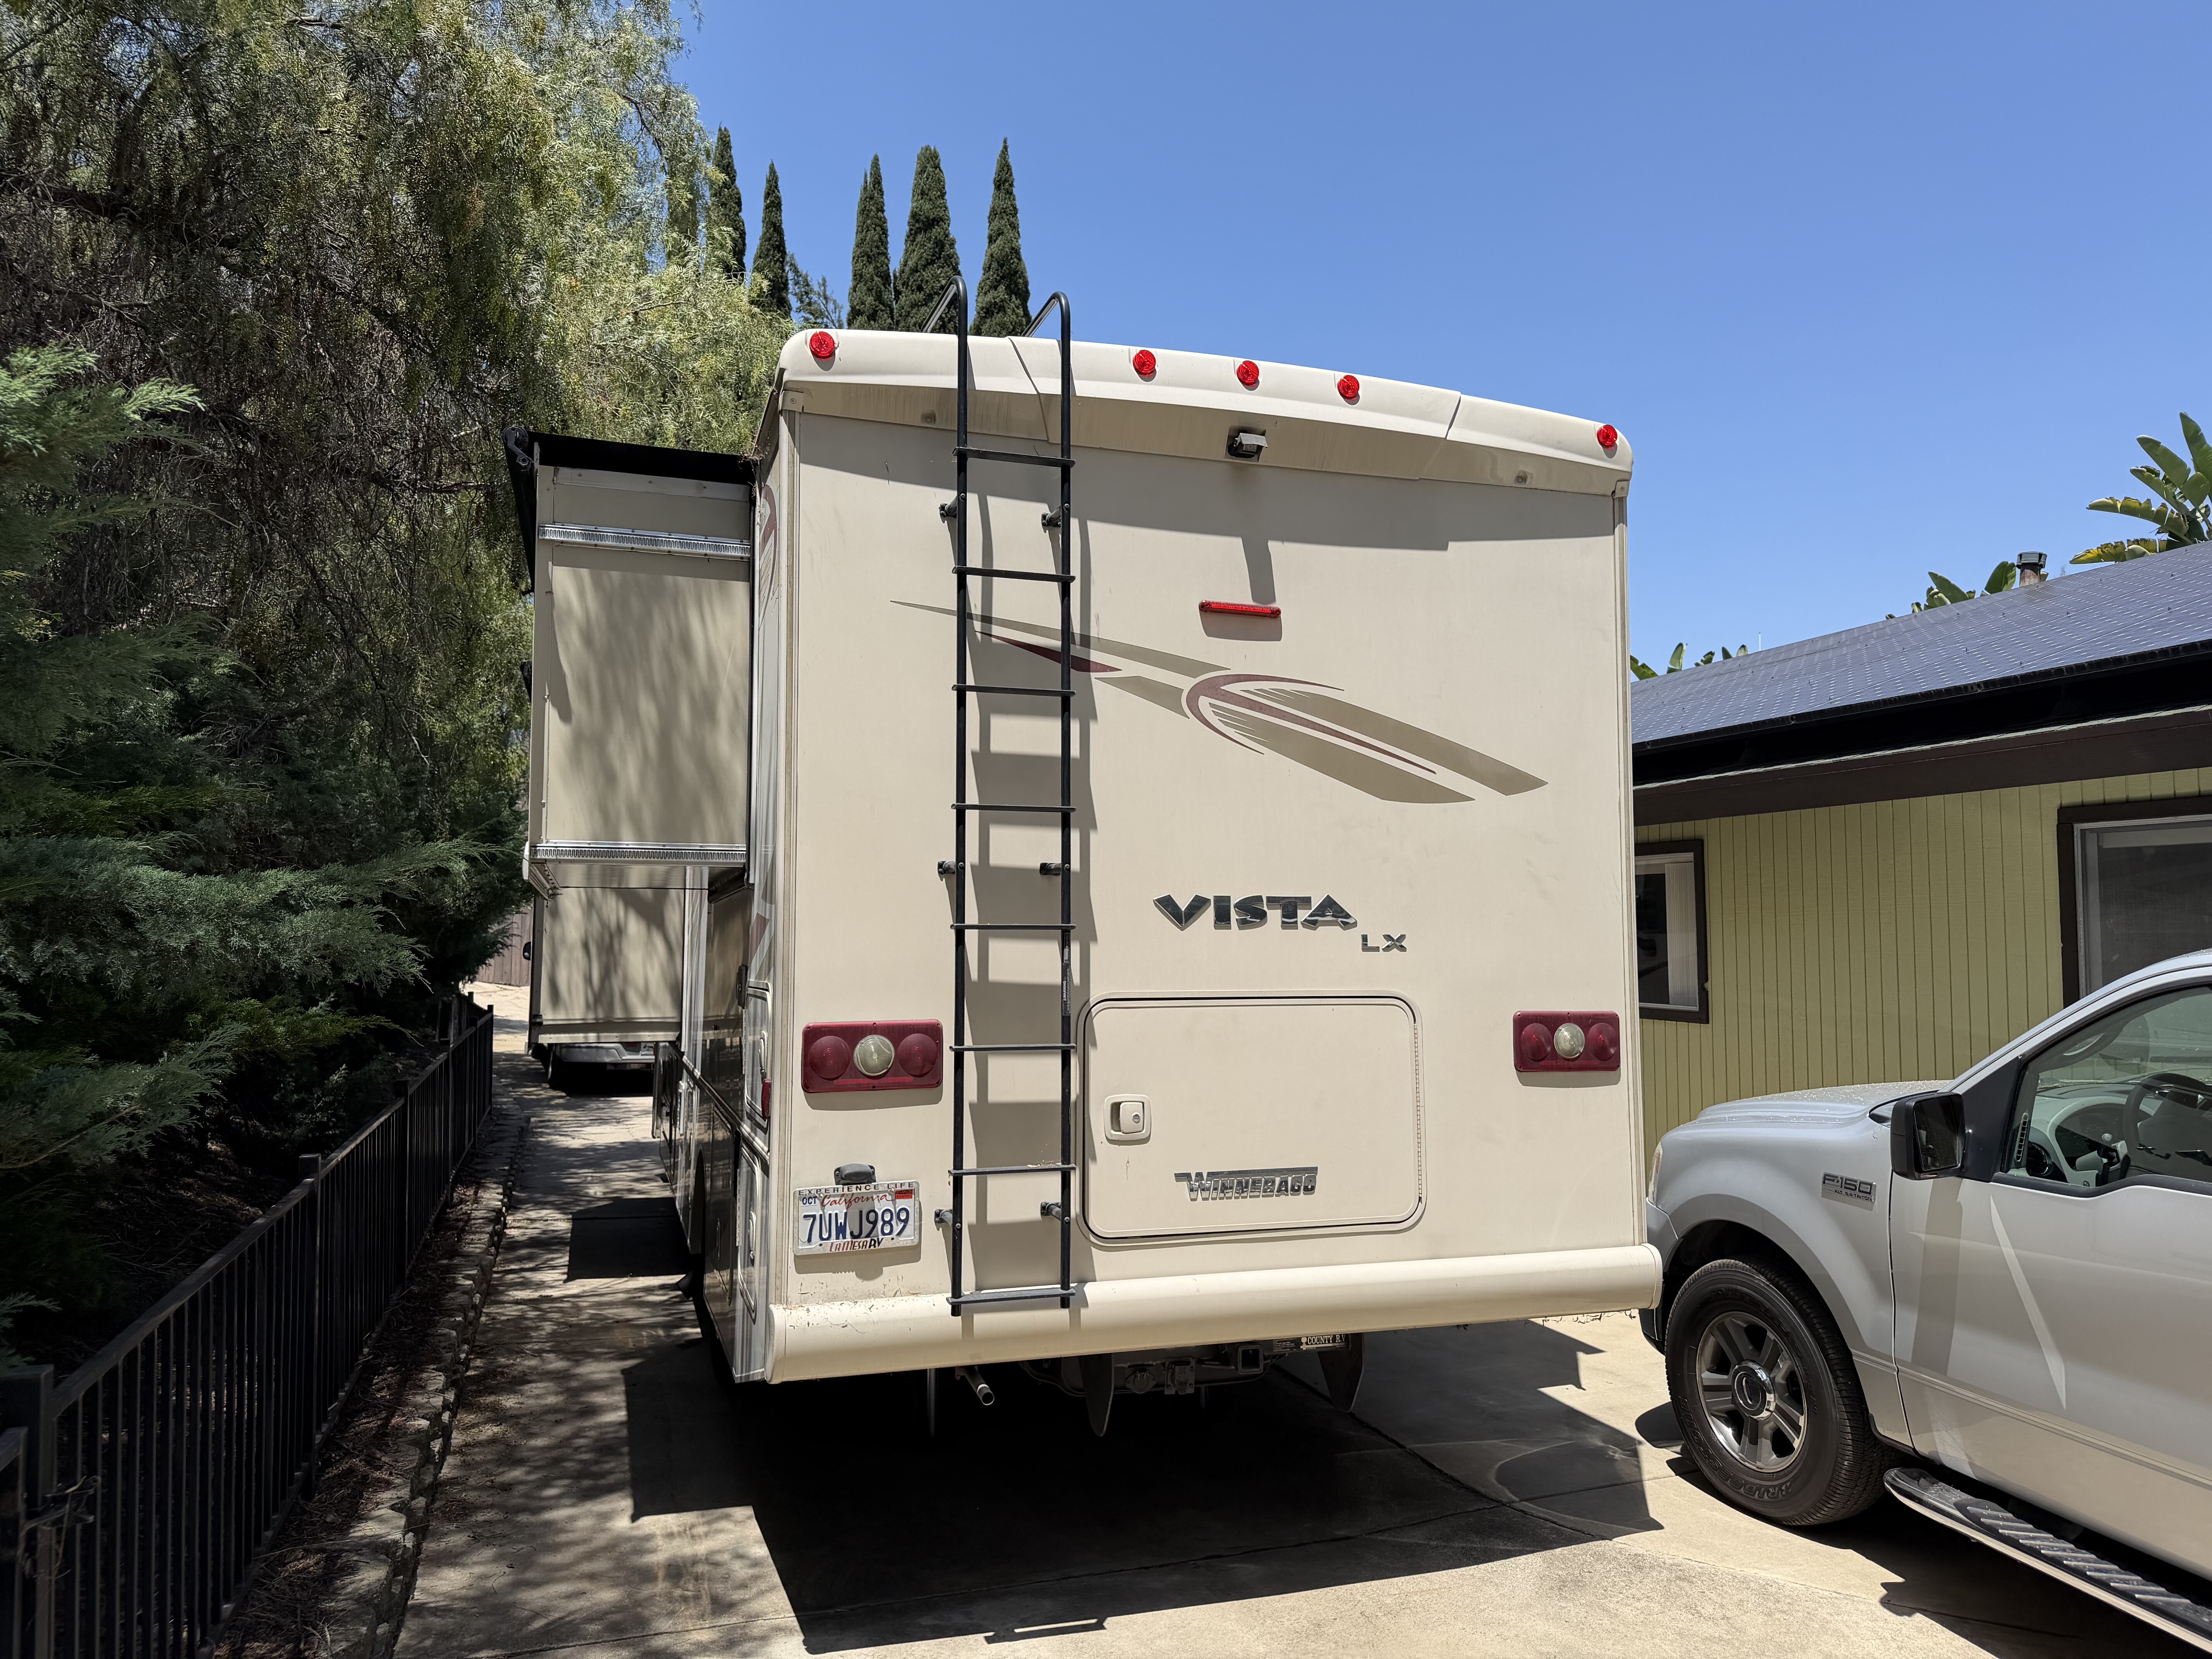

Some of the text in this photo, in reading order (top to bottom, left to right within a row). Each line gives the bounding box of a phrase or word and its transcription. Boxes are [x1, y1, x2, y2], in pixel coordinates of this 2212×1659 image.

[1153, 894, 1357, 931] VISTA
[1360, 934, 1407, 952] LX
[799, 1184, 879, 1195] EXPERIENCE
[1174, 1166, 1318, 1202] WINNEBAGO
[1823, 1173, 1872, 1195] F-150
[802, 1196, 817, 1205] OCT
[821, 1193, 895, 1209] California
[803, 1207, 910, 1243] 7UWJ989
[868, 1238, 884, 1249] RV
[1307, 1335, 1333, 1345] COUNTY
